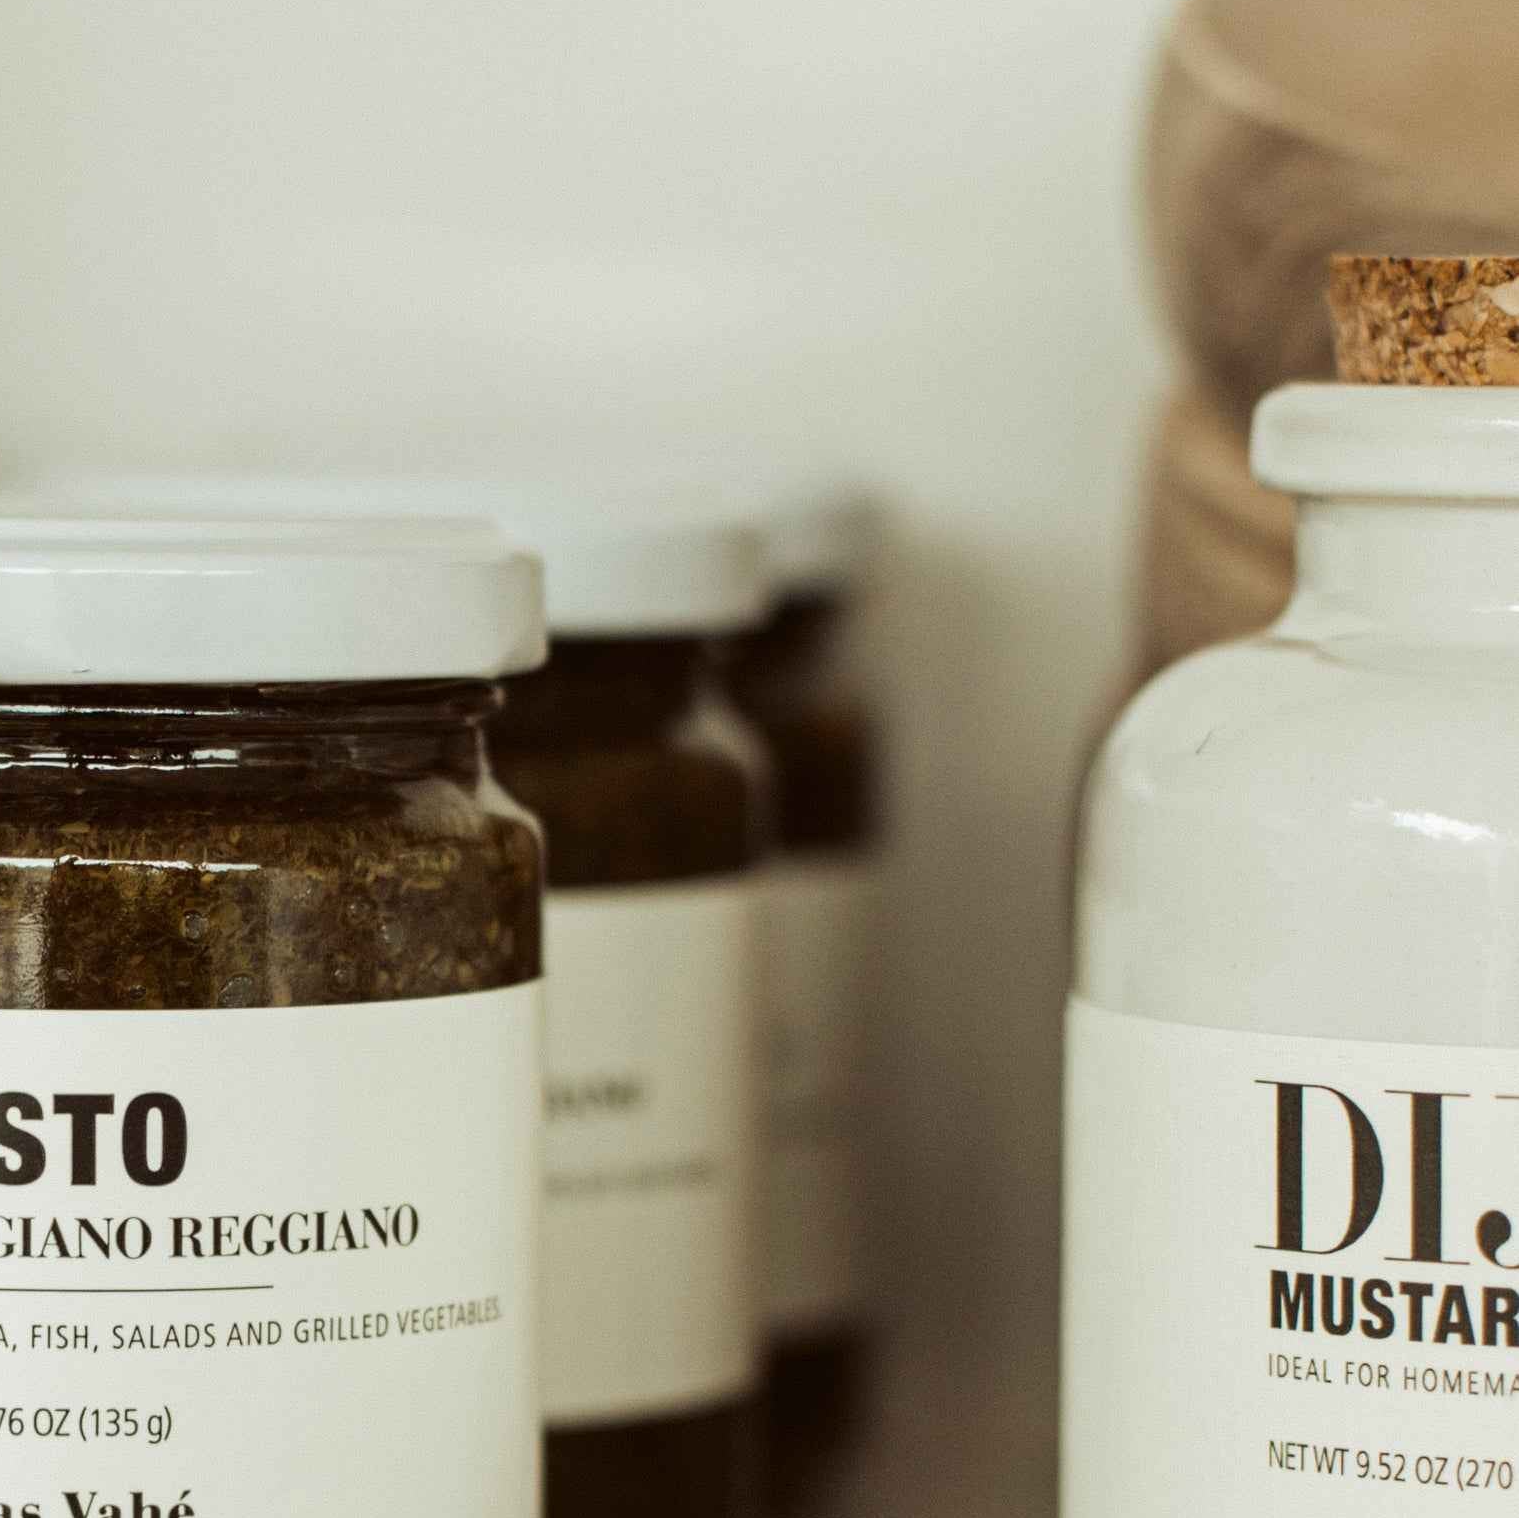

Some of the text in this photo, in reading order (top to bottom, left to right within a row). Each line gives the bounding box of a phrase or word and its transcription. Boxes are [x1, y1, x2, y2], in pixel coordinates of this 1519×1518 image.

[169, 1203, 420, 1258] REGGIANO
[31, 1324, 98, 1353] FISH,
[112, 1323, 216, 1350] SALADS
[226, 1320, 282, 1347] AND
[293, 1313, 389, 1344] GRILLED
[1269, 1353, 1332, 1384] IDEAL
[1345, 1361, 1390, 1389] FOR
[33, 1408, 70, 1437] OZ
[79, 1406, 139, 1442] (135
[1269, 1440, 1309, 1471] NET
[1312, 1445, 1349, 1476] WT
[1356, 1450, 1406, 1482] 9.52
[1415, 1455, 1448, 1486] OZ
